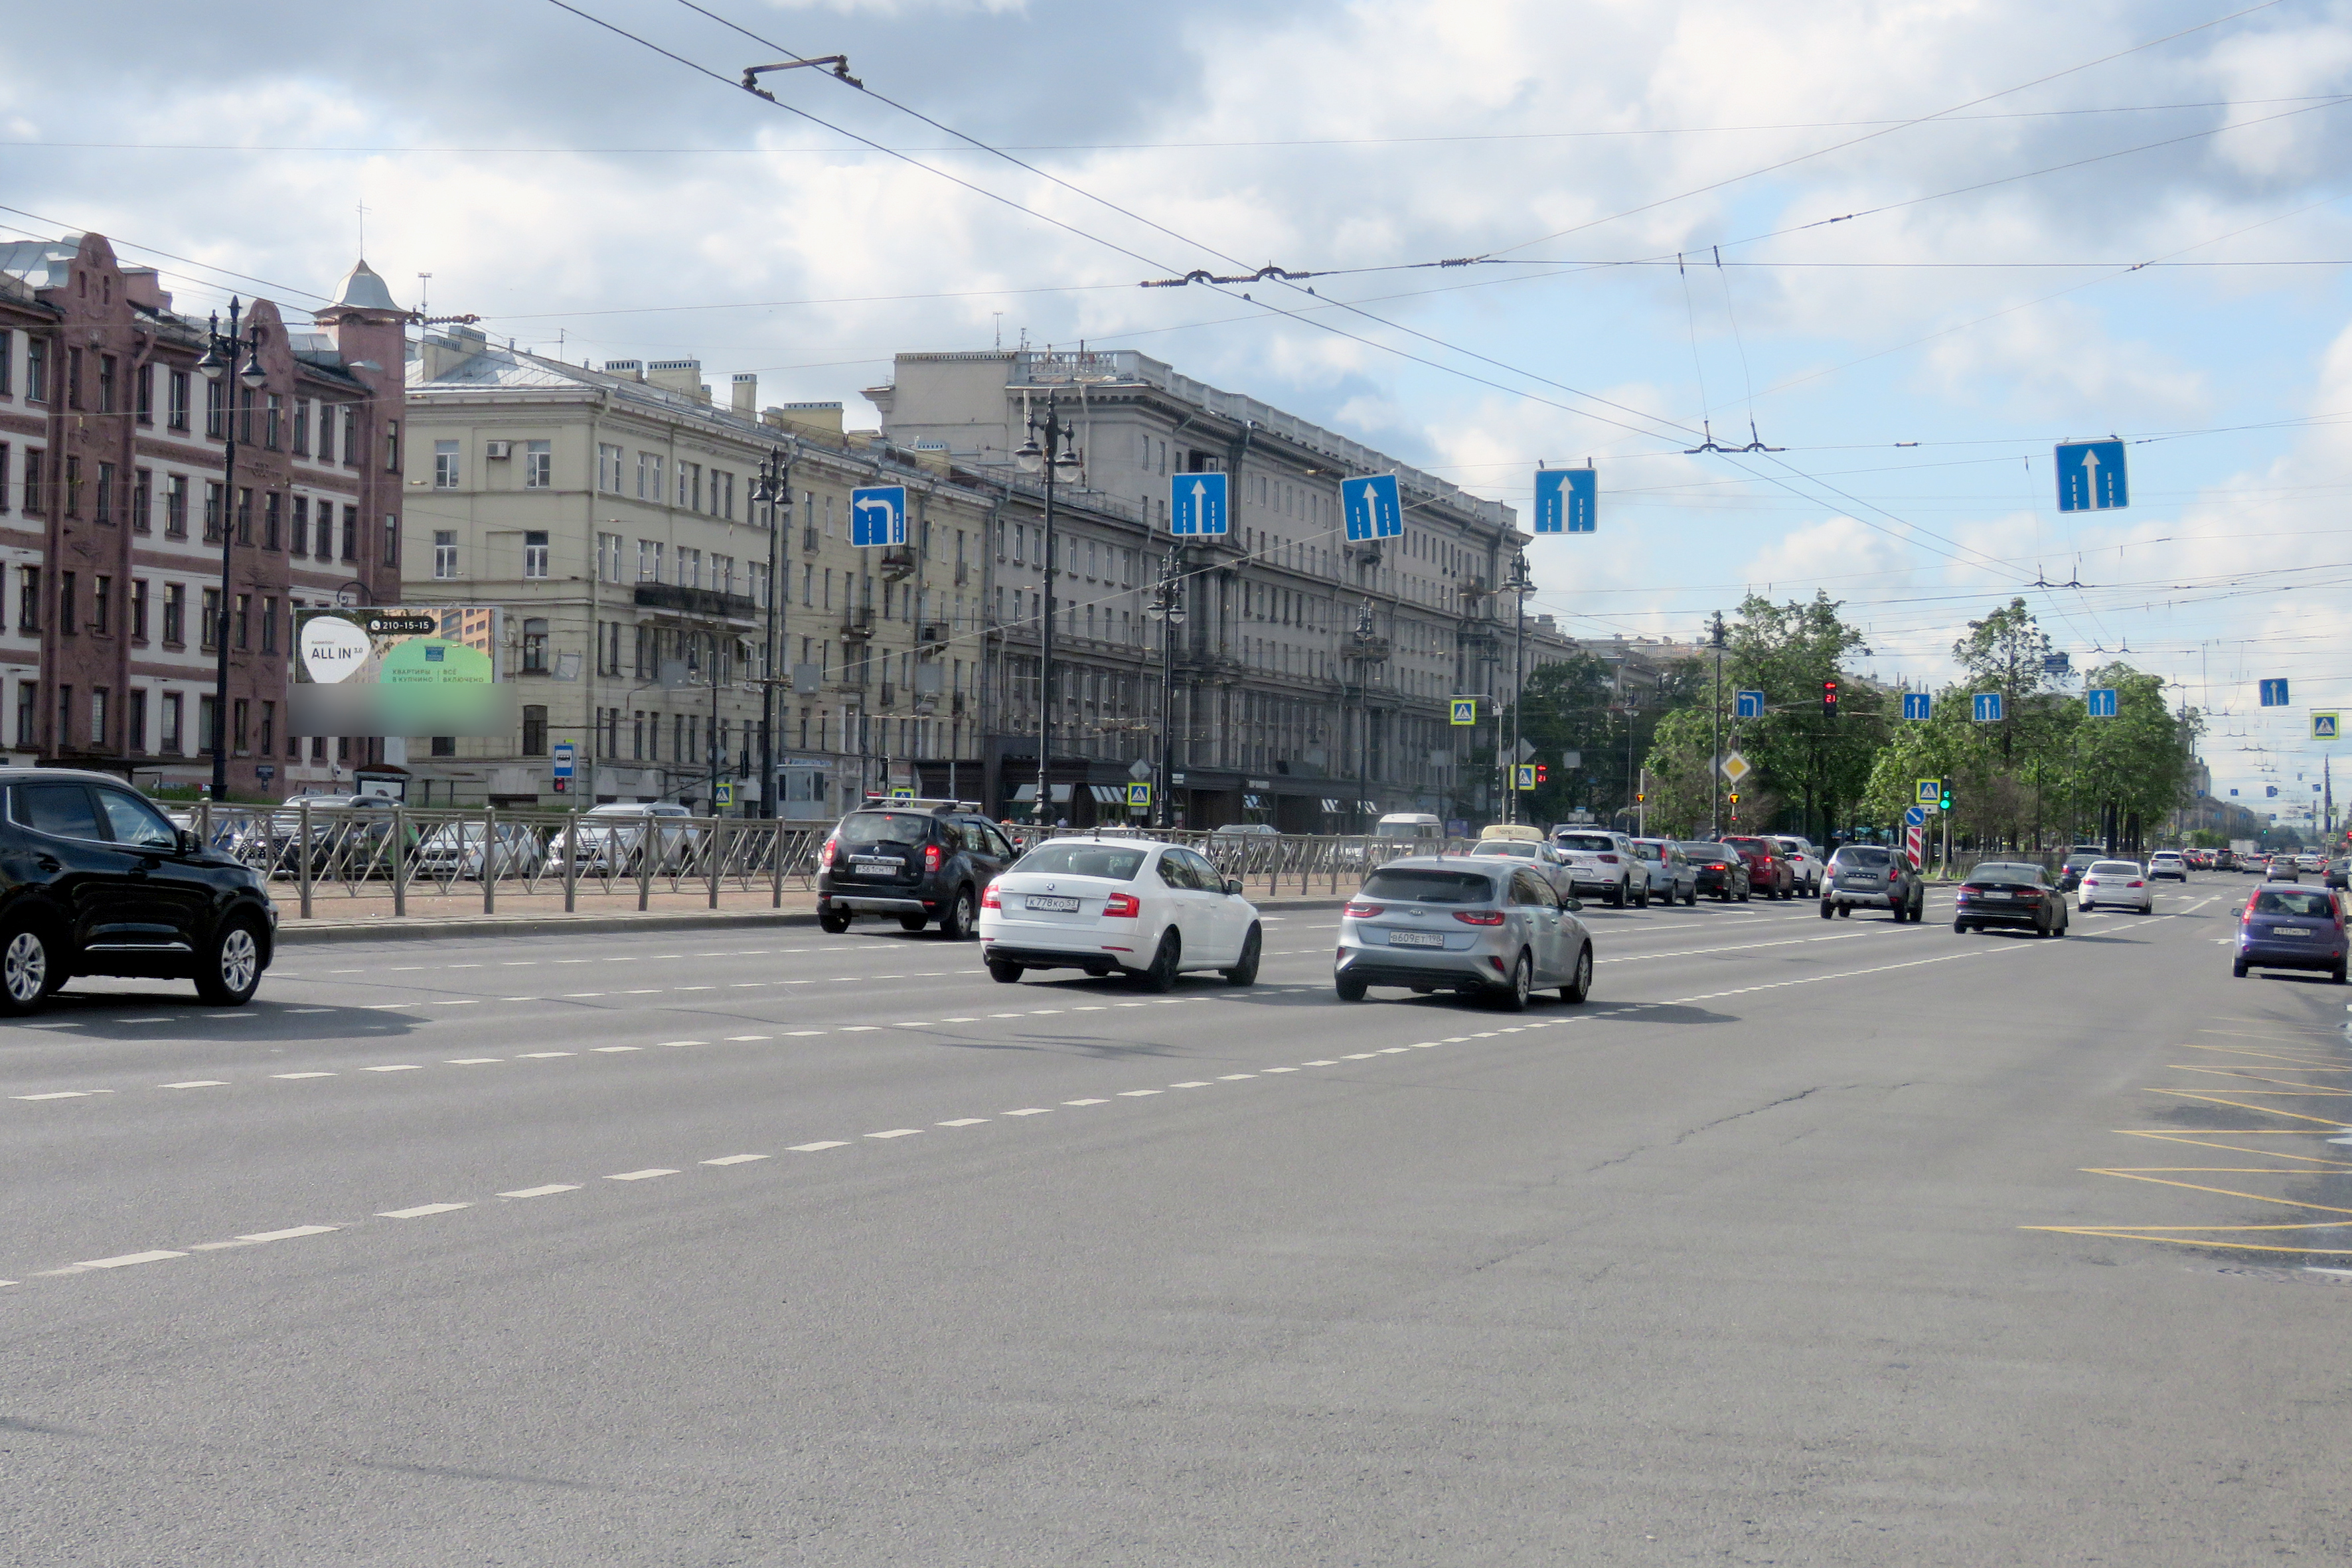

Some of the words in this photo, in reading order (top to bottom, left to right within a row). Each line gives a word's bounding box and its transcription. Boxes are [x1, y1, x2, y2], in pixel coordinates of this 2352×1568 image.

[311, 648, 335, 659] ALL
[339, 648, 351, 659] IN
[1826, 694, 1836, 703] 21
